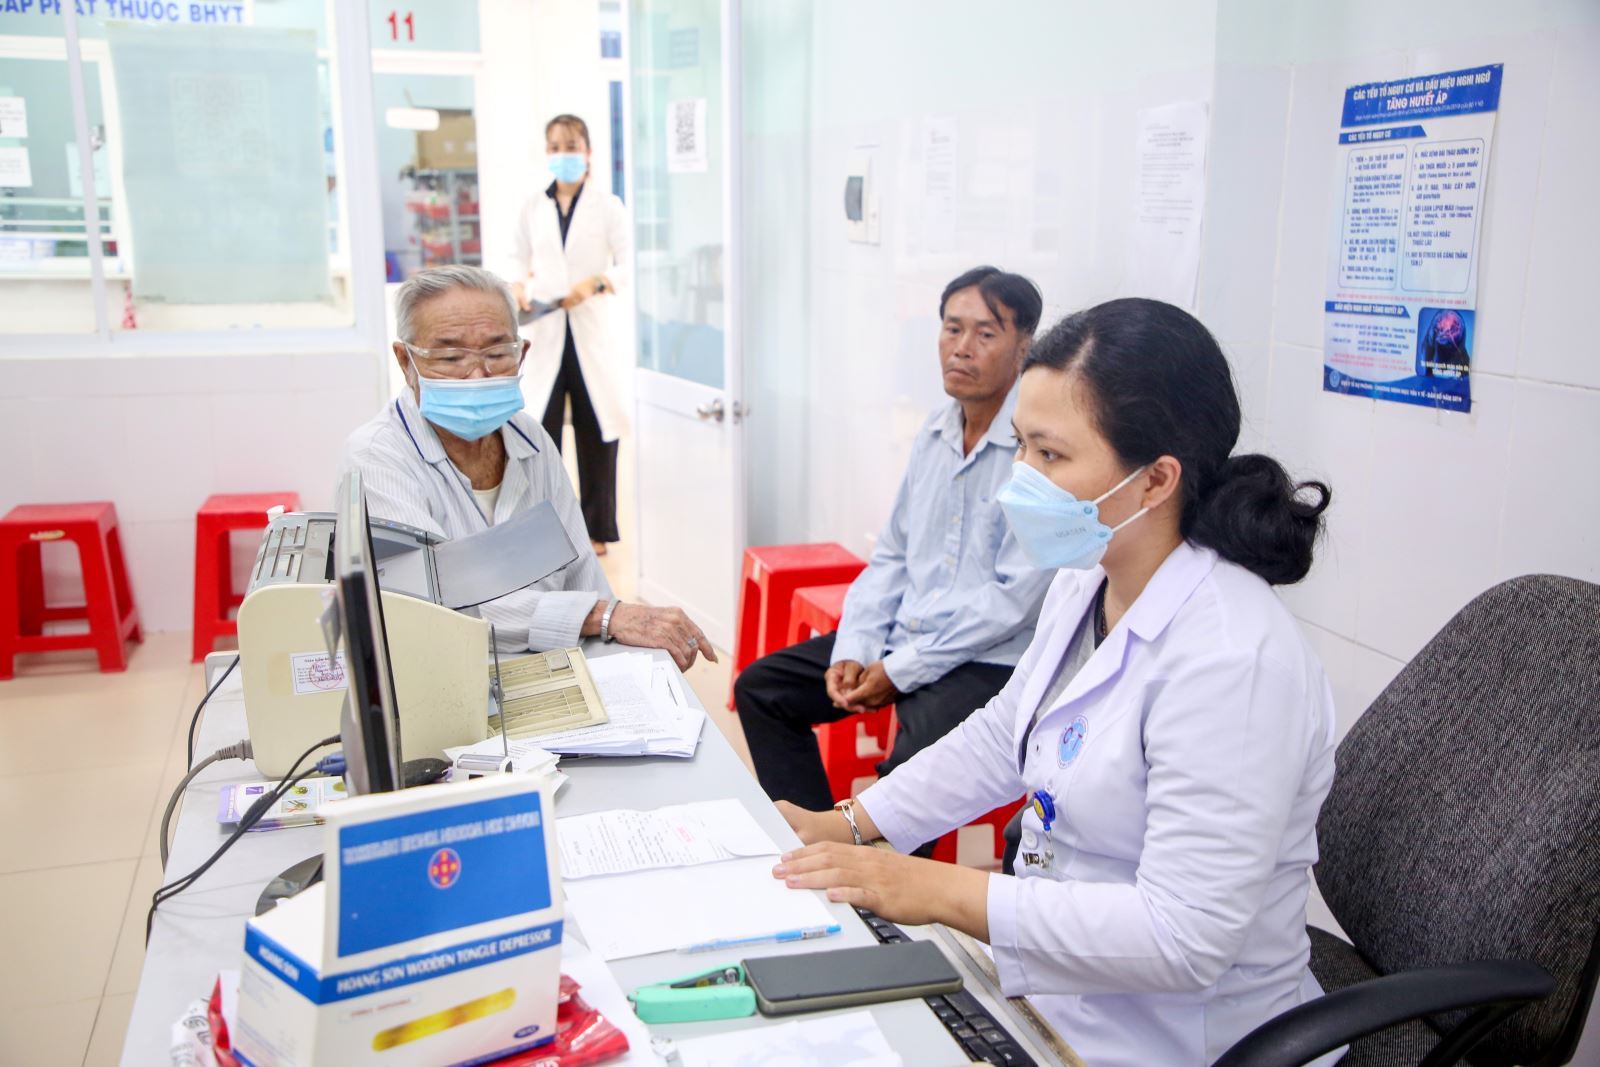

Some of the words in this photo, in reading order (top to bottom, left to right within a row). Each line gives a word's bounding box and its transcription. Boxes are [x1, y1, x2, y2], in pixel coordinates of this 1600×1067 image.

[189, 4, 243, 23] BHYT
[388, 10, 416, 42] 11
[1456, 73, 1474, 87] NGHI
[1387, 96, 1408, 110] TĂNG
[1409, 90, 1435, 108] HUYẾT
[1435, 89, 1448, 105] ÁP
[337, 971, 380, 993] HOANG
[382, 964, 405, 983] SON
[407, 953, 456, 977] WOODEN
[457, 941, 498, 966] TONGUE
[499, 928, 552, 955] DEPRESSOR
